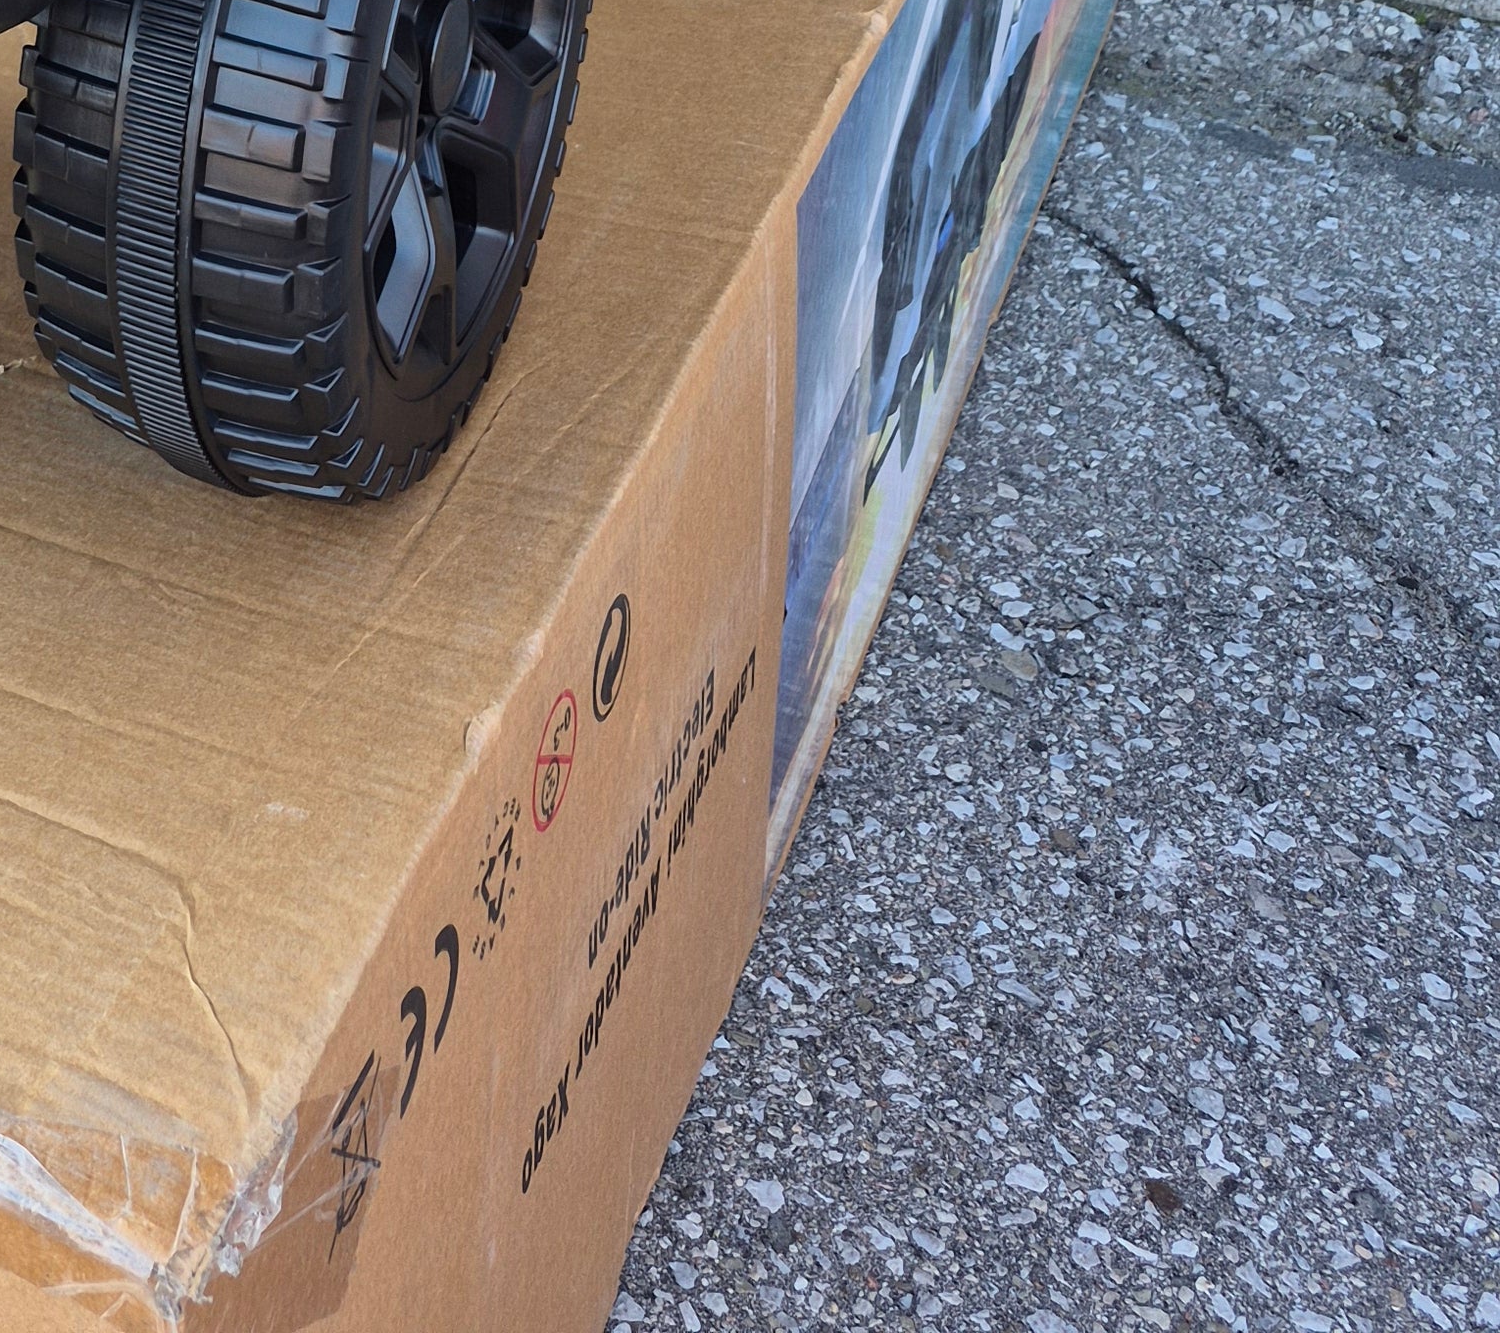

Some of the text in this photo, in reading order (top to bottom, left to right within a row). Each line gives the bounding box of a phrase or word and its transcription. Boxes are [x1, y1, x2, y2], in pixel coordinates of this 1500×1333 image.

[521, 645, 756, 1194] Lamborghini Aventador Xago
[587, 666, 715, 970] Electric Ride-on
